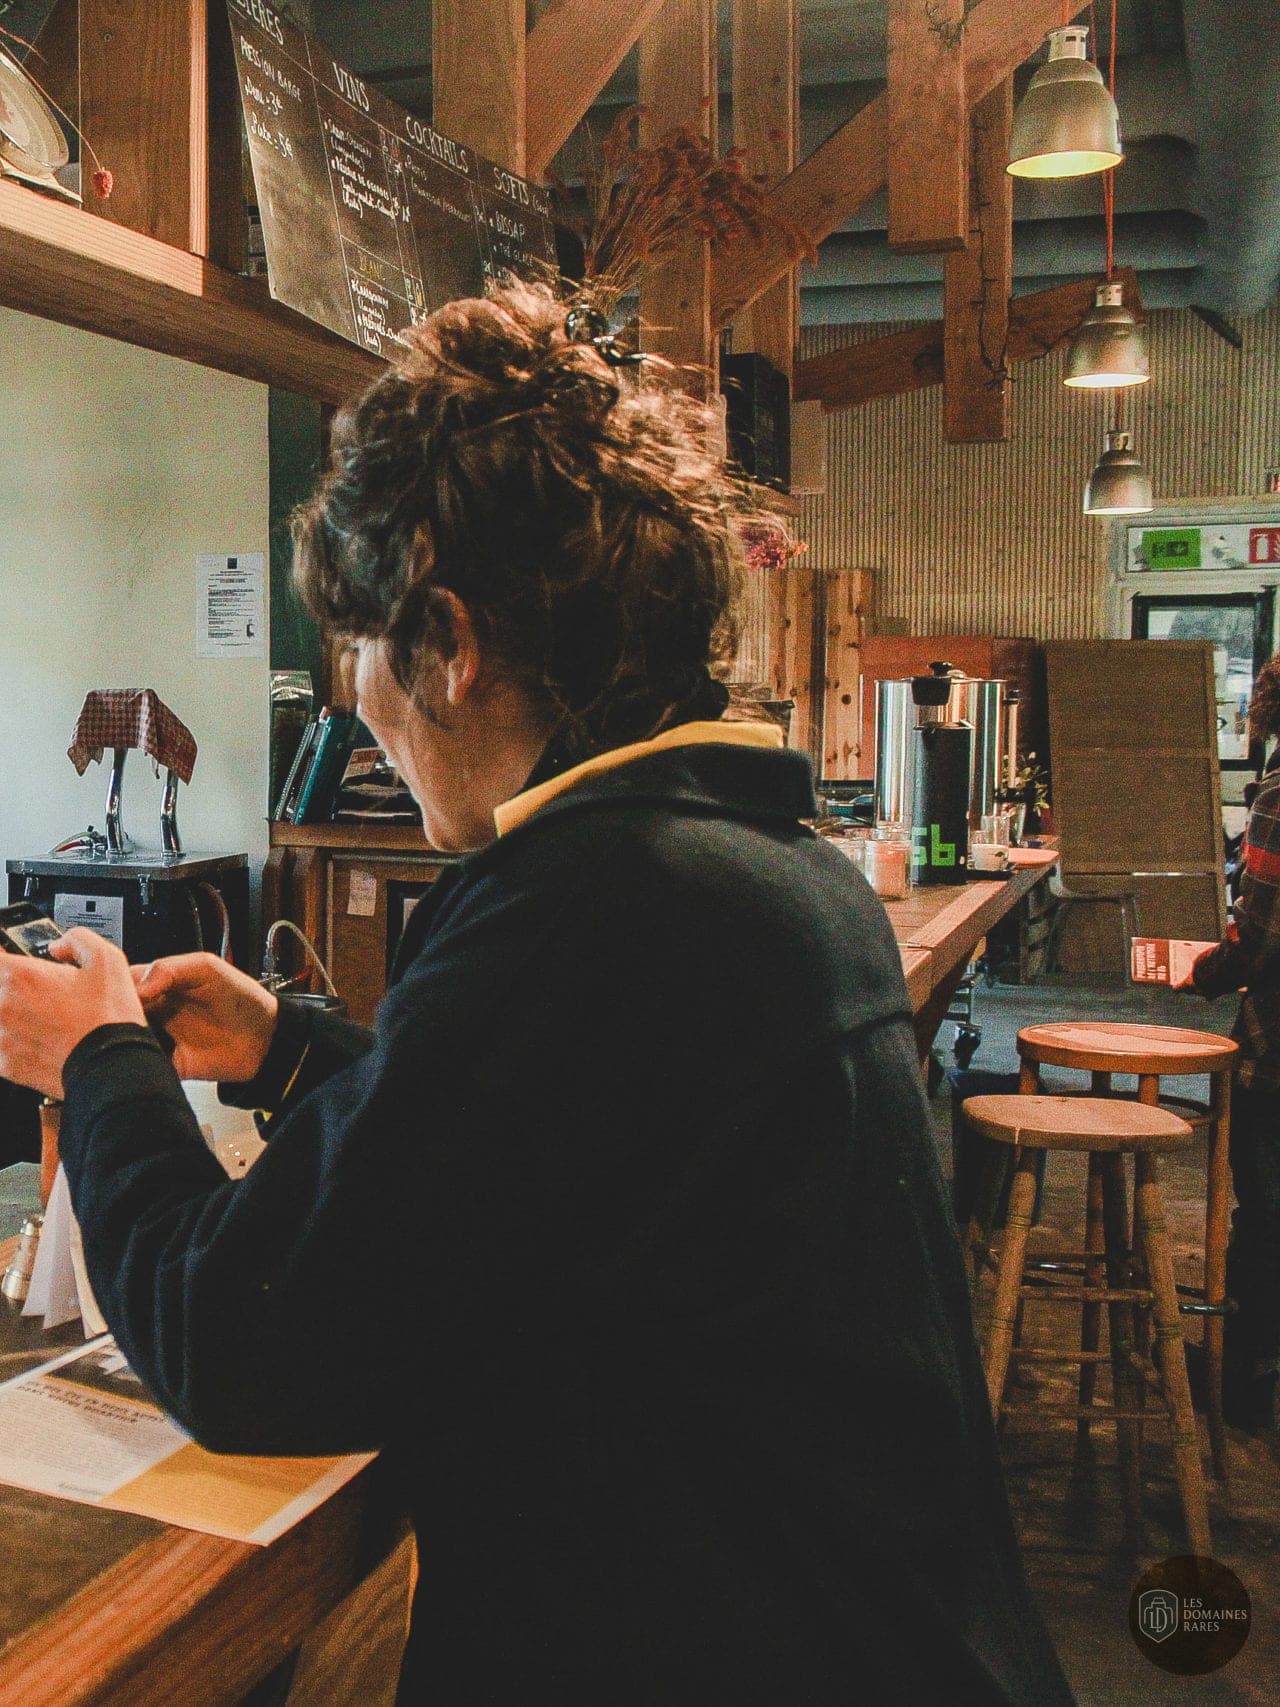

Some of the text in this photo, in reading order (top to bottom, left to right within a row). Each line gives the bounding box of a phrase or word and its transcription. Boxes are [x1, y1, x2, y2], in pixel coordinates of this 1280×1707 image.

[331, 61, 370, 112] VINS
[405, 115, 469, 174] COCKTAILS
[493, 166, 529, 205] SOFTS
